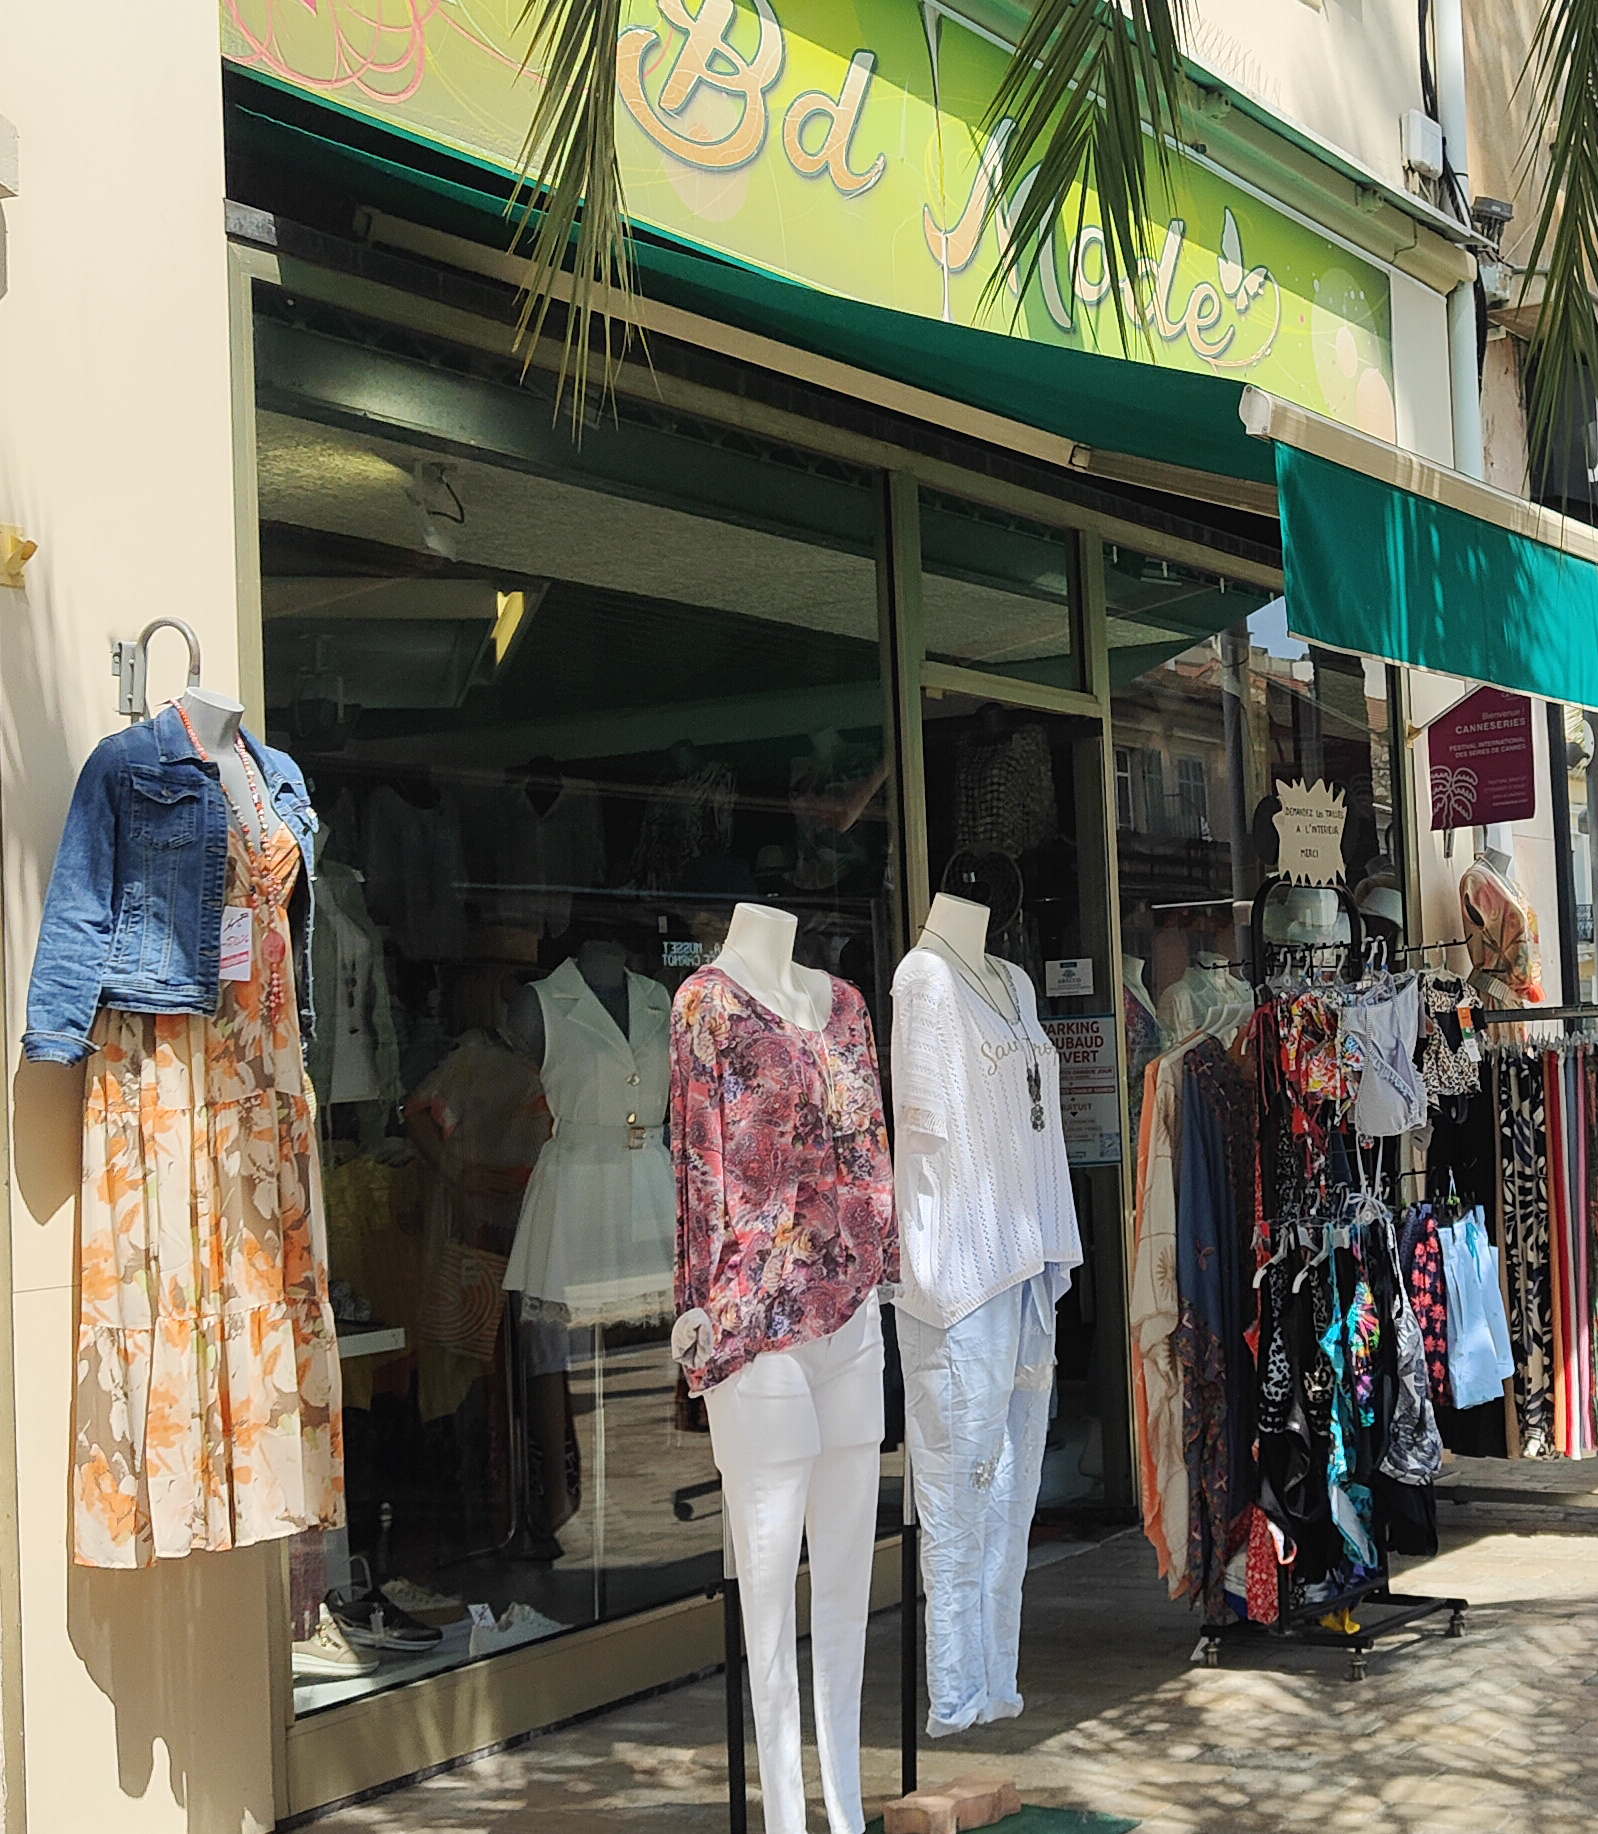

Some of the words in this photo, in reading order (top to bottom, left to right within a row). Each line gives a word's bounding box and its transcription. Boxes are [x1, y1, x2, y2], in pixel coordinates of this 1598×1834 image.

[616, 0, 886, 199] Bd
[1455, 717, 1526, 735] CANNESERIES
[1449, 742, 1478, 752] FESTIVAL
[1478, 736, 1526, 748] INTERNATIONAL
[1300, 848, 1319, 858] MERCI
[1050, 1035, 1104, 1050] UBAUD
[1059, 1050, 1099, 1064] VERT
